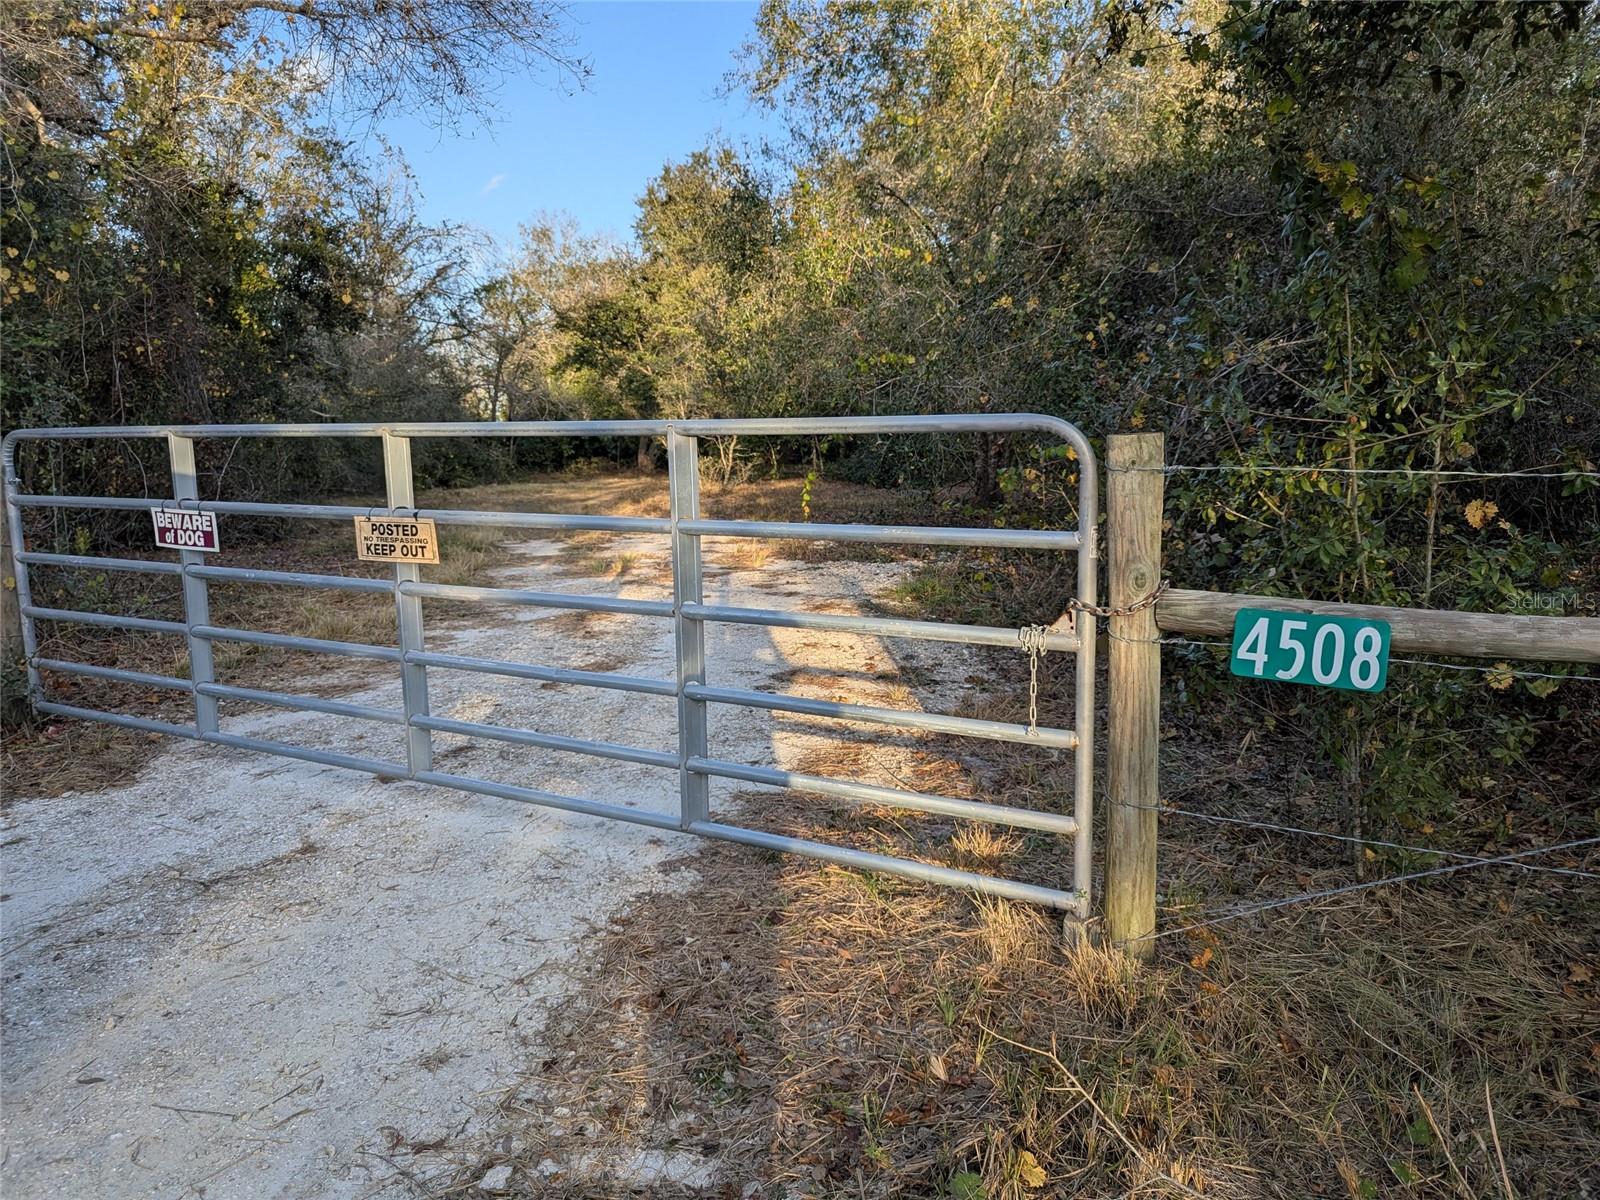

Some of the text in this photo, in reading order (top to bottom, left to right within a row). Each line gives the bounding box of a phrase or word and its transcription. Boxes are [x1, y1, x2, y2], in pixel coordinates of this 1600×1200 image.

[156, 512, 212, 531] BEWARE
[165, 529, 205, 546] of DOG
[371, 523, 418, 537] POSTED
[376, 536, 429, 545] TRESPASSING
[366, 543, 427, 557] KEEP OUT
[1236, 617, 1382, 690] 4508
